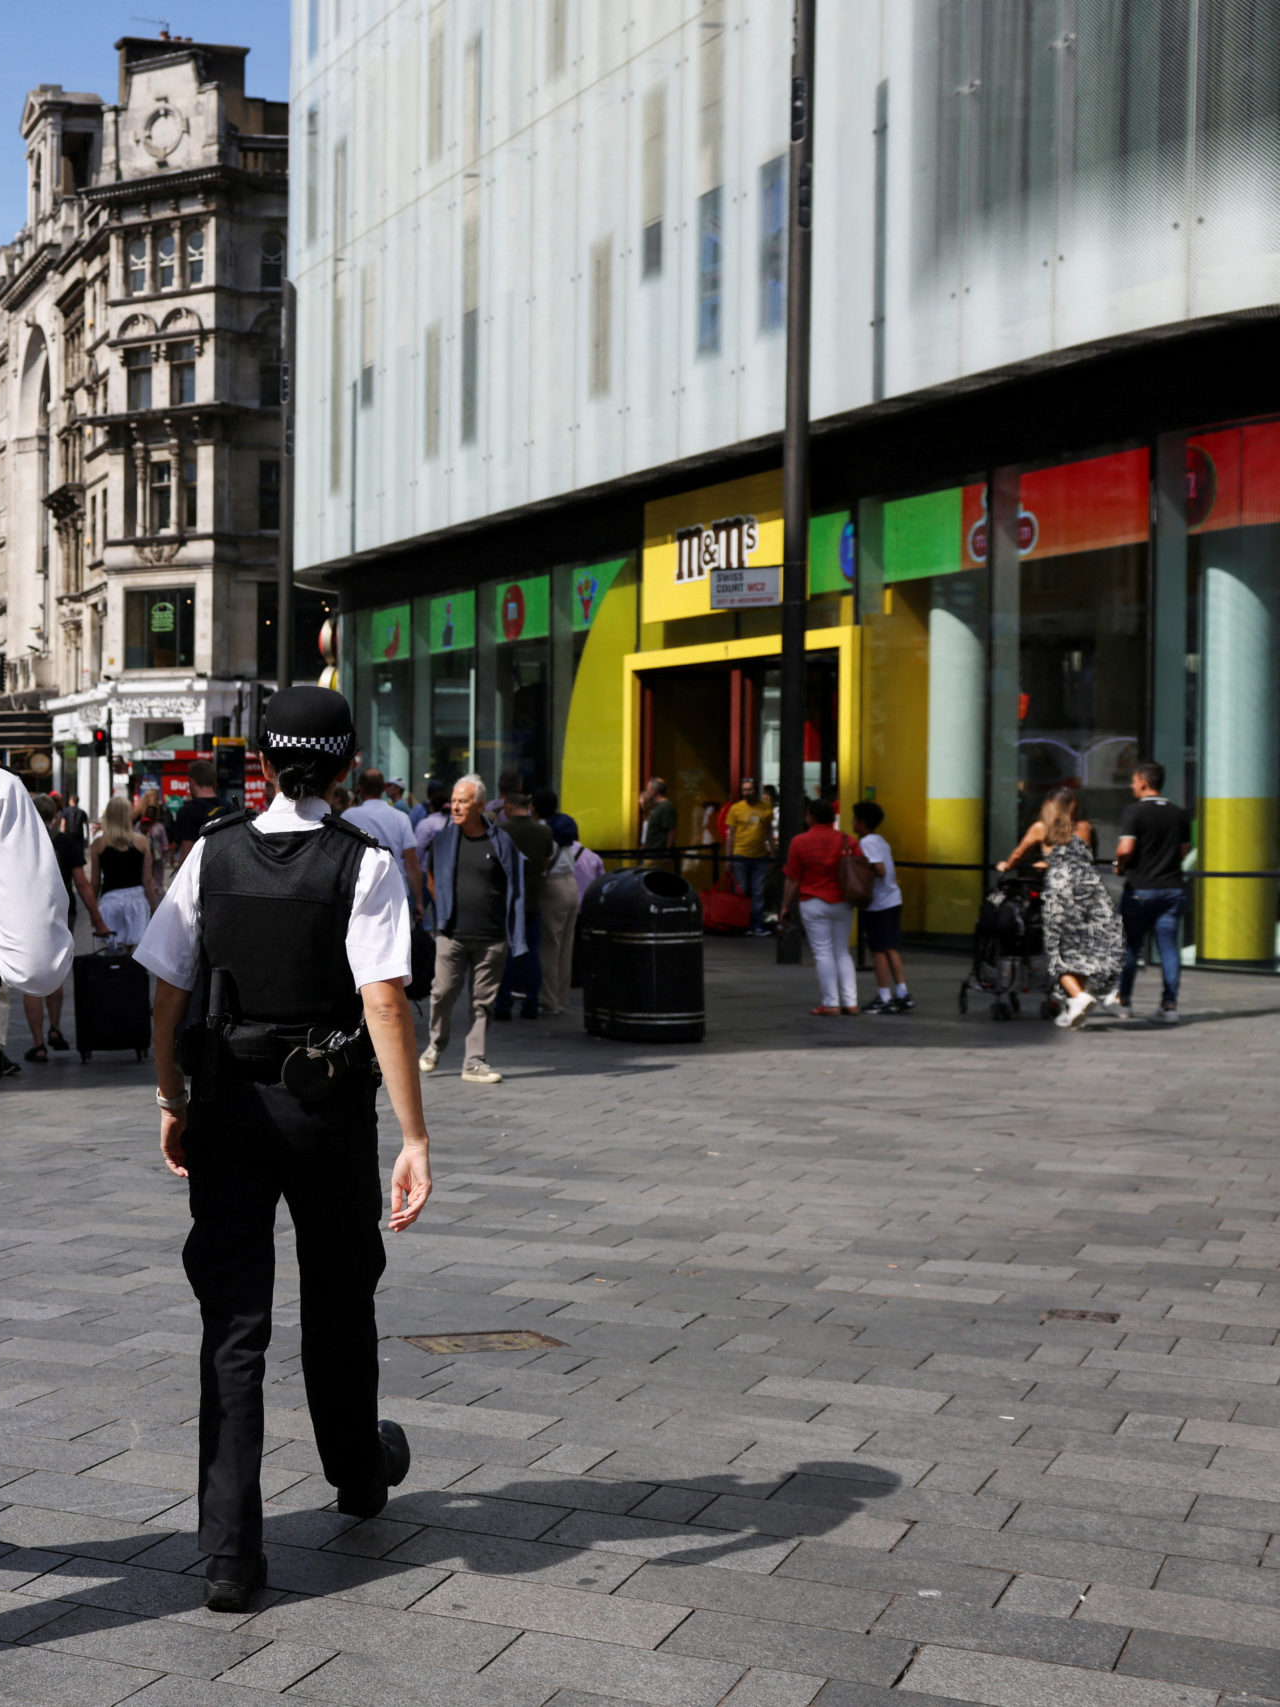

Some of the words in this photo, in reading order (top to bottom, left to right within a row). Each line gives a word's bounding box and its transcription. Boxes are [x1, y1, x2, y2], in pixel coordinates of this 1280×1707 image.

[716, 572, 744, 582] SWISS
[716, 583, 744, 593] COURT
[747, 582, 766, 592] WC2
